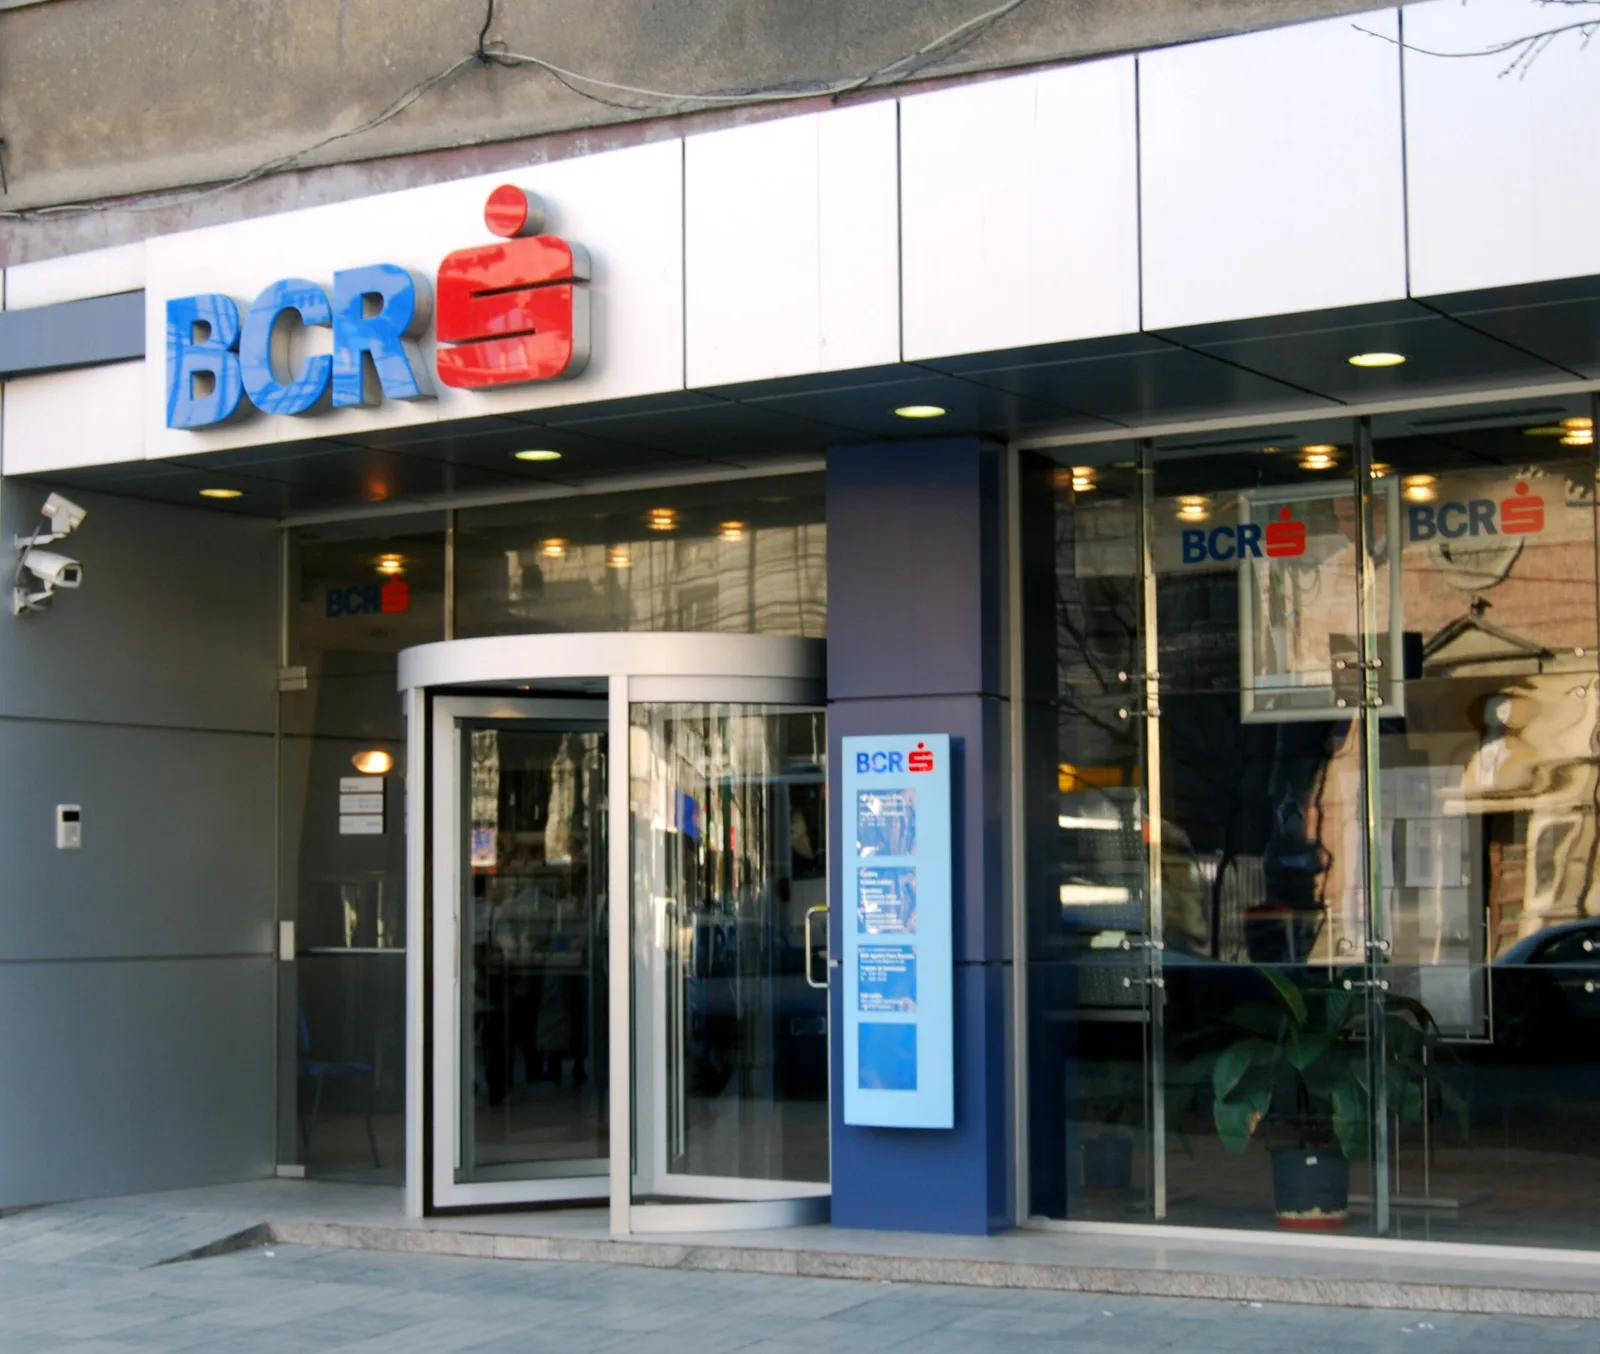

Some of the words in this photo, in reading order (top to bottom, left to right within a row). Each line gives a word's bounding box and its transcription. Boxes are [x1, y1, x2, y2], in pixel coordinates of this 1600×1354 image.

[166, 263, 436, 430] BCR
[1408, 499, 1498, 542] BCR
[1182, 523, 1264, 564] BCR
[326, 586, 380, 618] BCR
[856, 752, 904, 774] BCR
